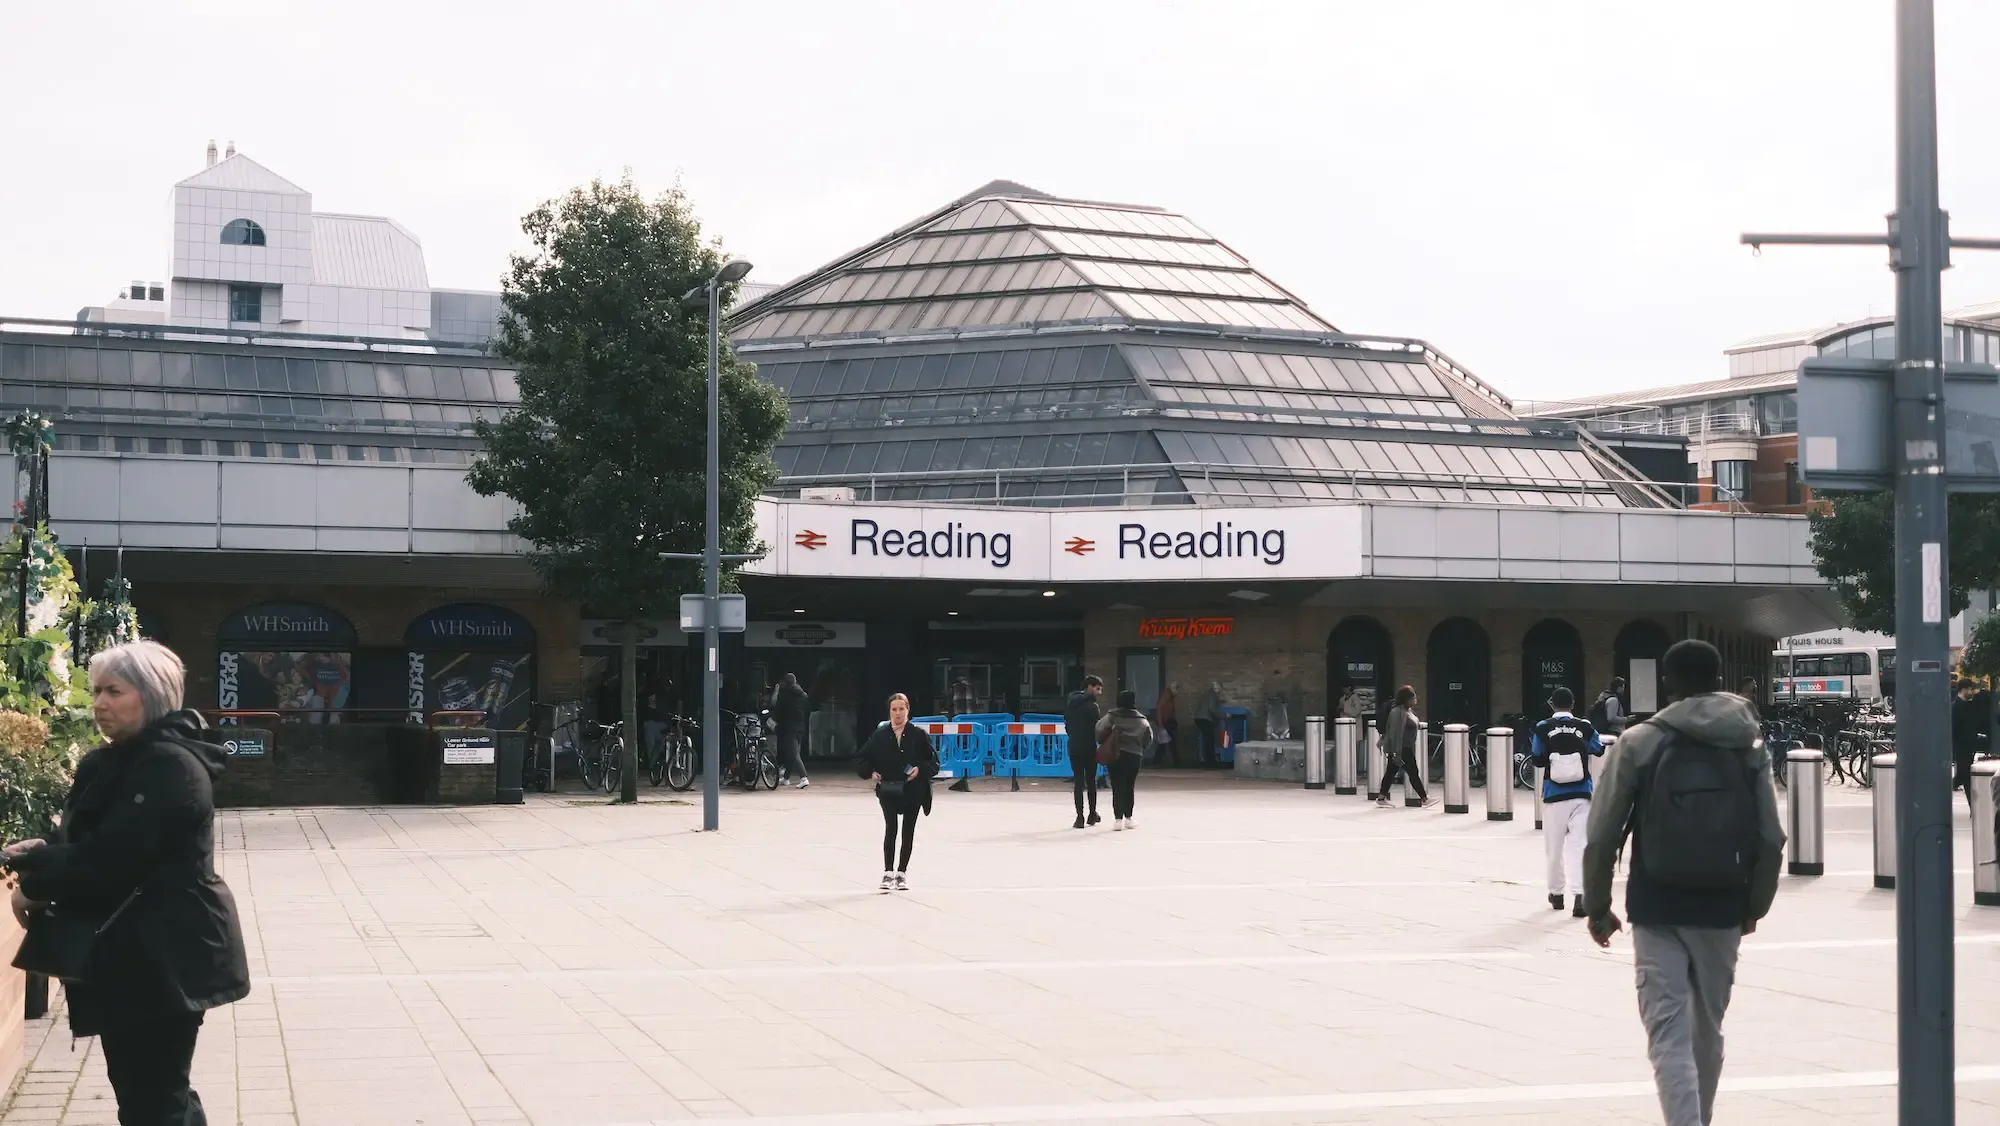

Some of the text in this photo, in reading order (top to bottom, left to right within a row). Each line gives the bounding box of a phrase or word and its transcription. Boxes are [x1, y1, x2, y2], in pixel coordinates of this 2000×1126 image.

[850, 518, 1012, 568] Reading
[1118, 521, 1286, 566] Reading
[244, 615, 329, 631] WHSmith
[430, 619, 512, 636] WHSmith
[1138, 617, 1188, 640] Krispy
[1541, 662, 1565, 673] M&S
